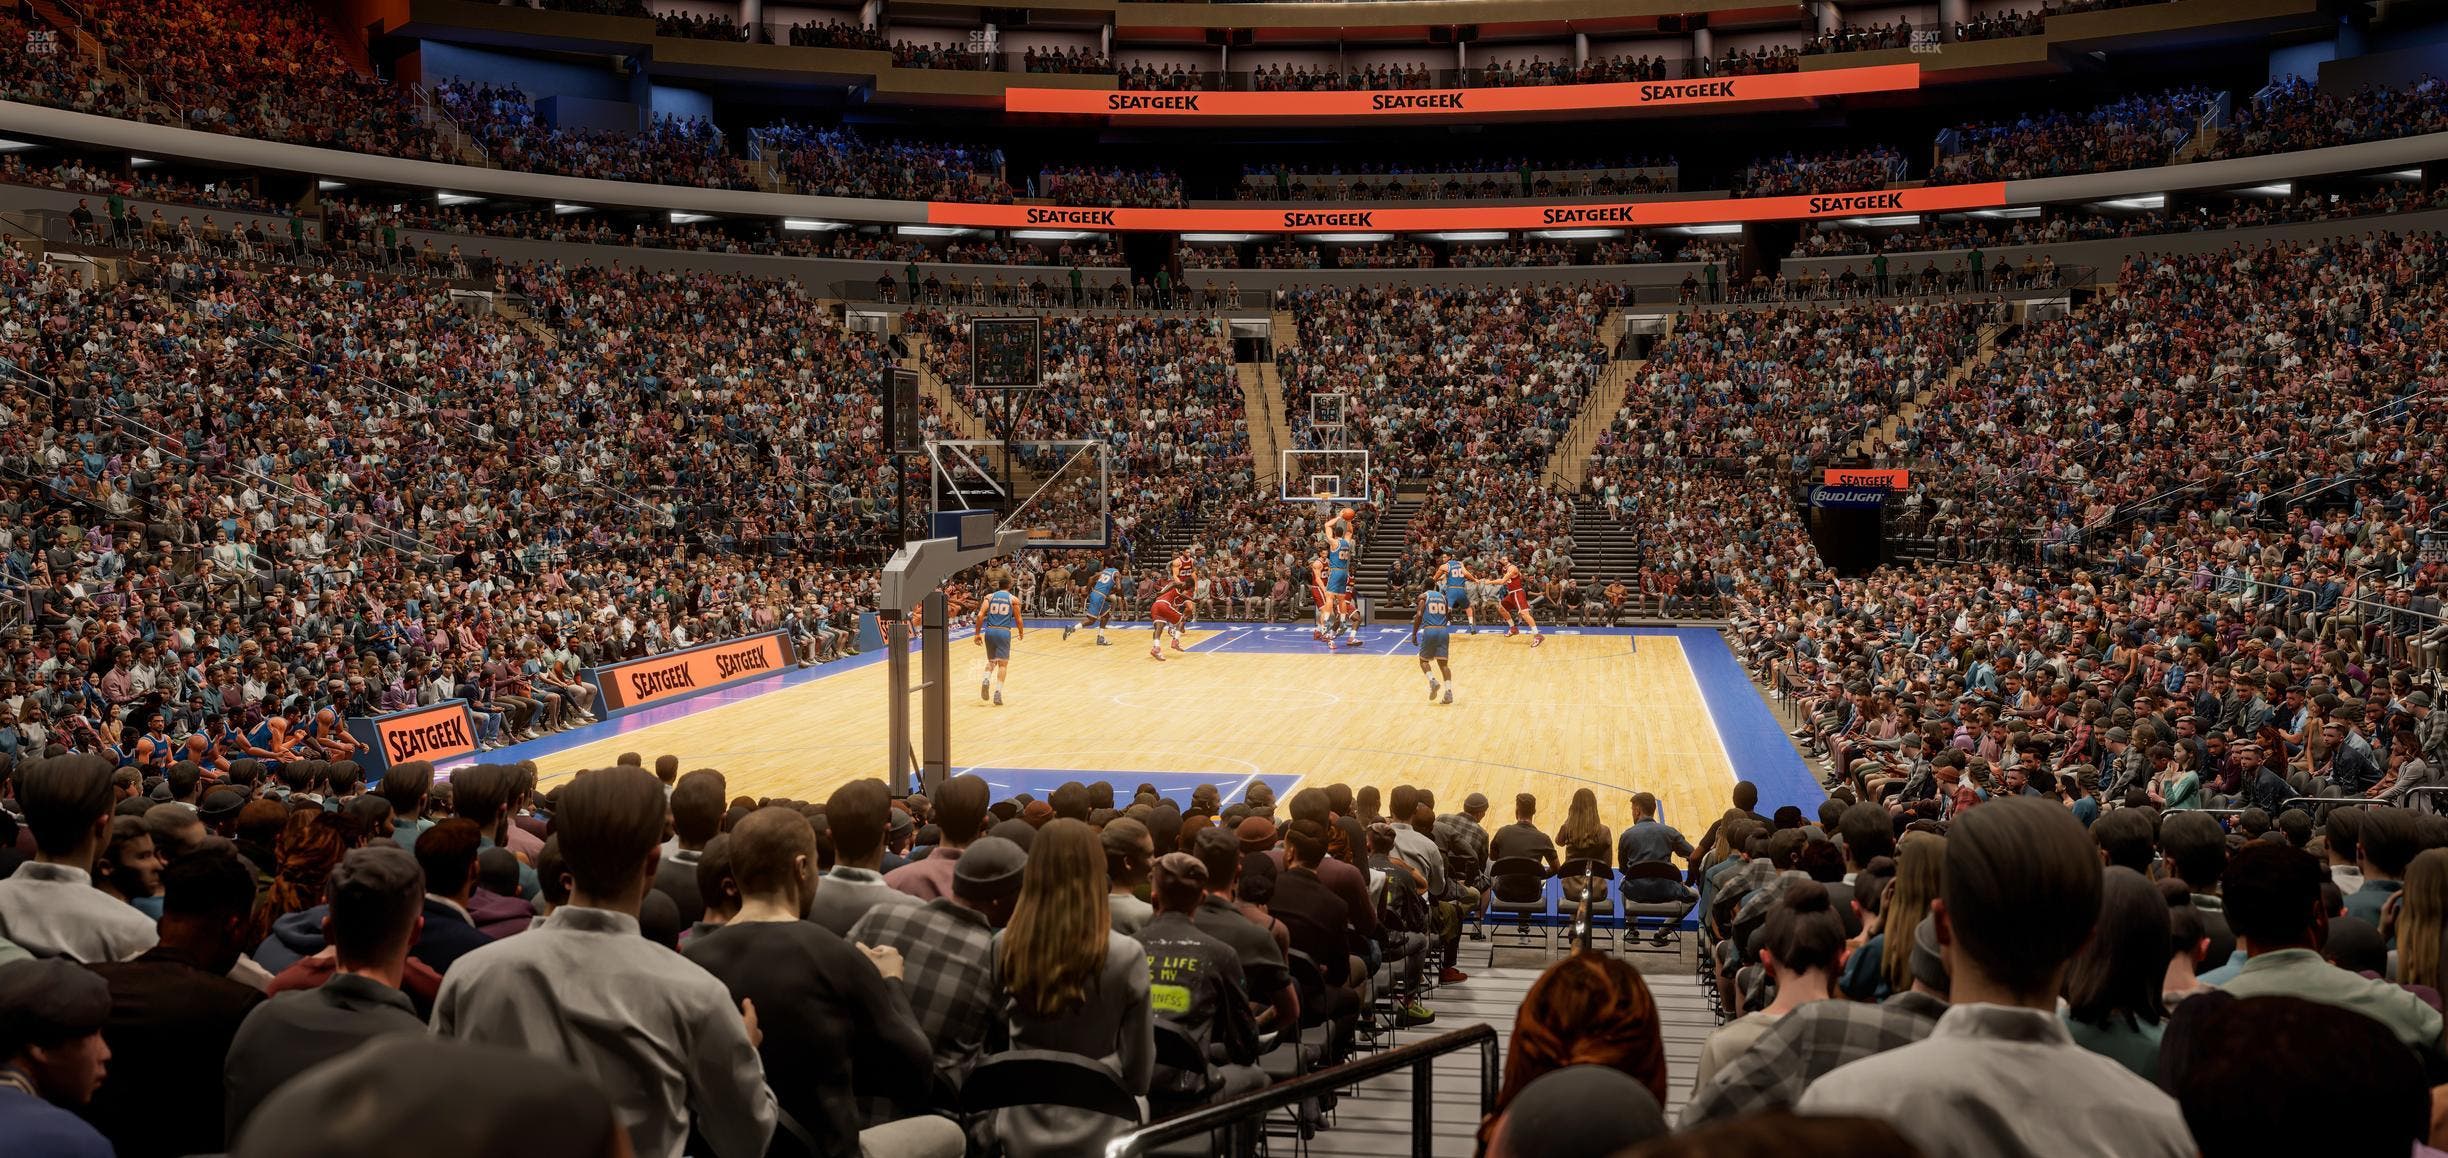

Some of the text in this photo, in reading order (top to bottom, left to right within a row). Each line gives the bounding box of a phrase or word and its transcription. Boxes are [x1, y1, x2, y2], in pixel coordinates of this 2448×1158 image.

[1641, 80, 1735, 102] SEATGEEK
[1109, 94, 1199, 111] SEATGEEK
[1373, 93, 1464, 110] SEATGEEK
[1810, 191, 1903, 214] SEATGEEK
[1027, 208, 1115, 226] SEATGEEK
[1284, 211, 1373, 228] SEATGEEK
[1544, 206, 1634, 224] SEATGEEK
[1840, 475, 1895, 486] SEATGEEK
[1816, 491, 1883, 502] BUD LIGHT
[990, 603, 1010, 615] 00
[1428, 602, 1448, 615] 00
[716, 645, 770, 679] SEATGEEK
[632, 661, 696, 700] SEATGEEK
[388, 715, 470, 763] SEATGEEK
[1163, 956, 1198, 972] LIFE
[1160, 969, 1178, 981] MY
